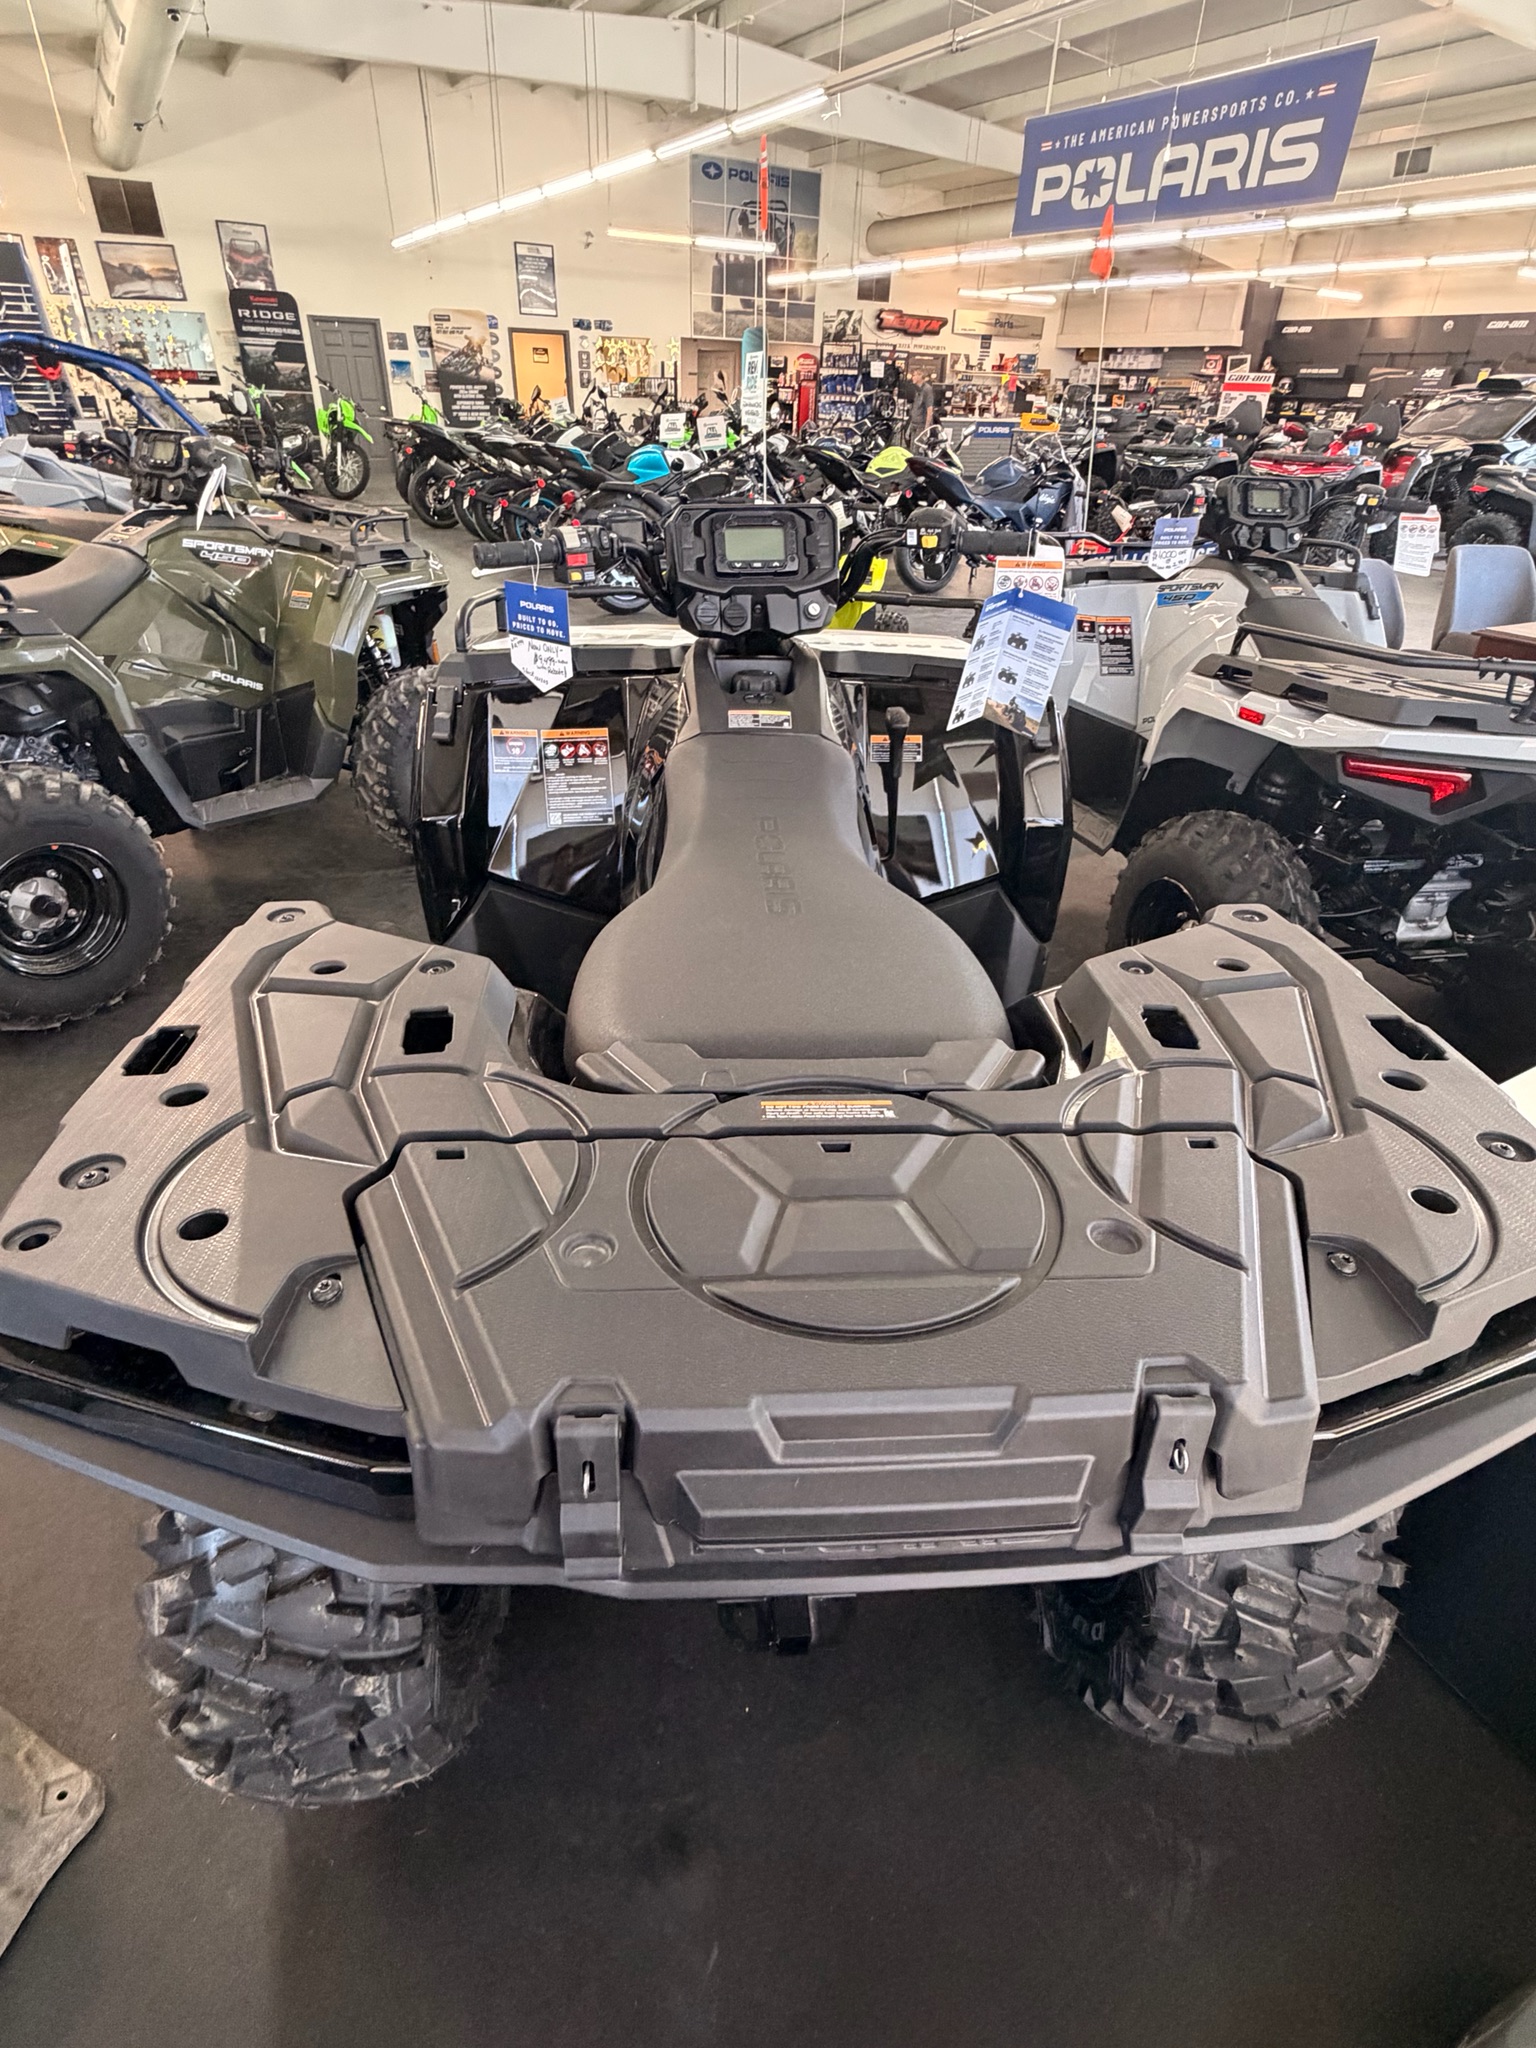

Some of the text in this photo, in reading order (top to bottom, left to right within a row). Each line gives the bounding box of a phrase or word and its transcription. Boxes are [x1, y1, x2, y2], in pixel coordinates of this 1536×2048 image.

[1061, 88, 1300, 149] THE AMERICAN POWERSPORTS CO.
[1031, 117, 1325, 216] POLARIS
[237, 308, 296, 321] RIDGE
[994, 318, 1014, 329] Parts
[978, 426, 1010, 434] POLARIS
[182, 538, 274, 558] SPORTSMAN
[200, 550, 251, 566] 450
[1156, 582, 1224, 593] SPORTSMAN
[1163, 593, 1198, 601] 450
[519, 600, 555, 614] POLARIS
[518, 613, 559, 628] BUILT TO GO.
[512, 621, 566, 639] PRICED TO MOVE.
[211, 670, 264, 691] POLARIS
